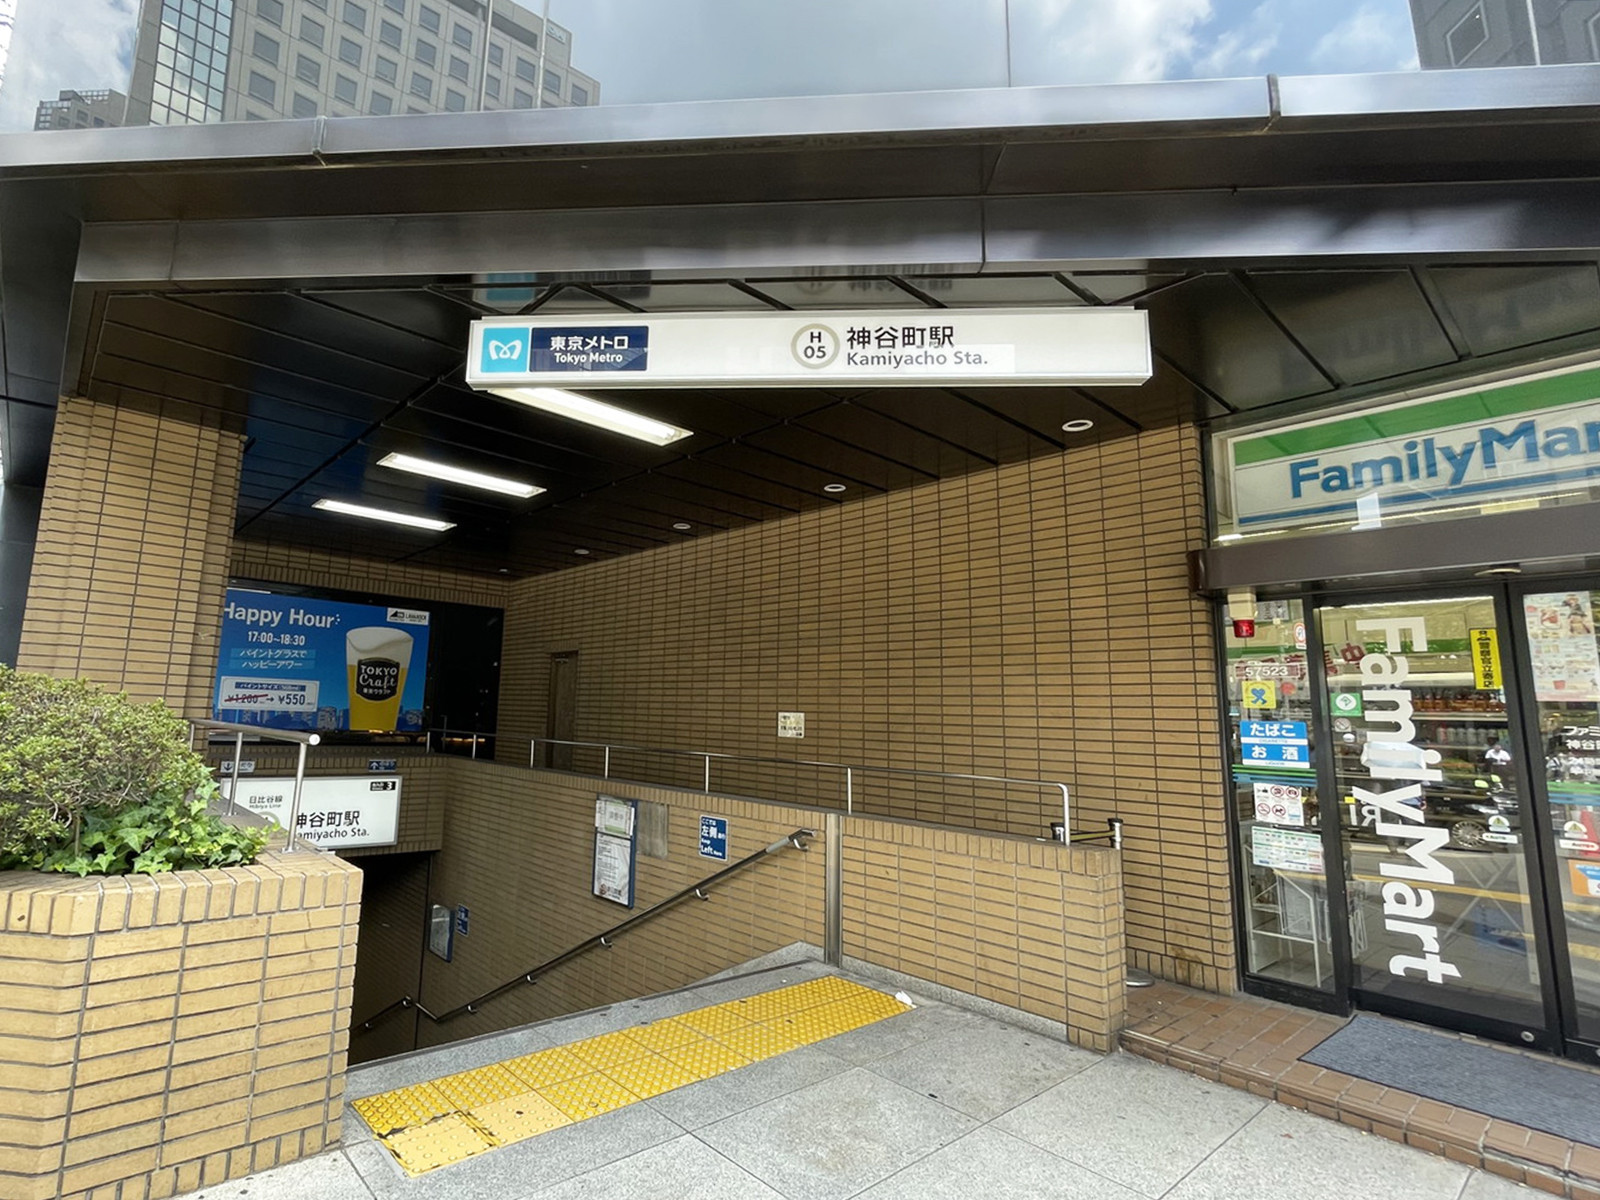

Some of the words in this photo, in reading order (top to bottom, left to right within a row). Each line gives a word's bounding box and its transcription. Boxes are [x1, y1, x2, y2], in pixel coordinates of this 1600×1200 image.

[550, 336, 628, 351] 東京メトロ
[810, 331, 822, 343] H
[847, 326, 955, 349] 神谷町駅
[554, 353, 587, 365] Tokyo
[589, 352, 623, 363] Metro
[803, 346, 827, 359] 05
[847, 351, 947, 368] Kamiyacho
[954, 350, 988, 366] Sta.
[289, 608, 335, 629] Hour
[361, 665, 398, 676] TOKYO
[1245, 665, 1289, 677] 57523
[360, 673, 397, 689] Craft
[278, 694, 306, 706] ¥550
[1250, 723, 1296, 737] たばこ
[386, 781, 393, 790] 3
[1352, 615, 1462, 984] FamilyMart
[297, 828, 348, 842] amiyacho
[351, 828, 370, 838] Sta.
